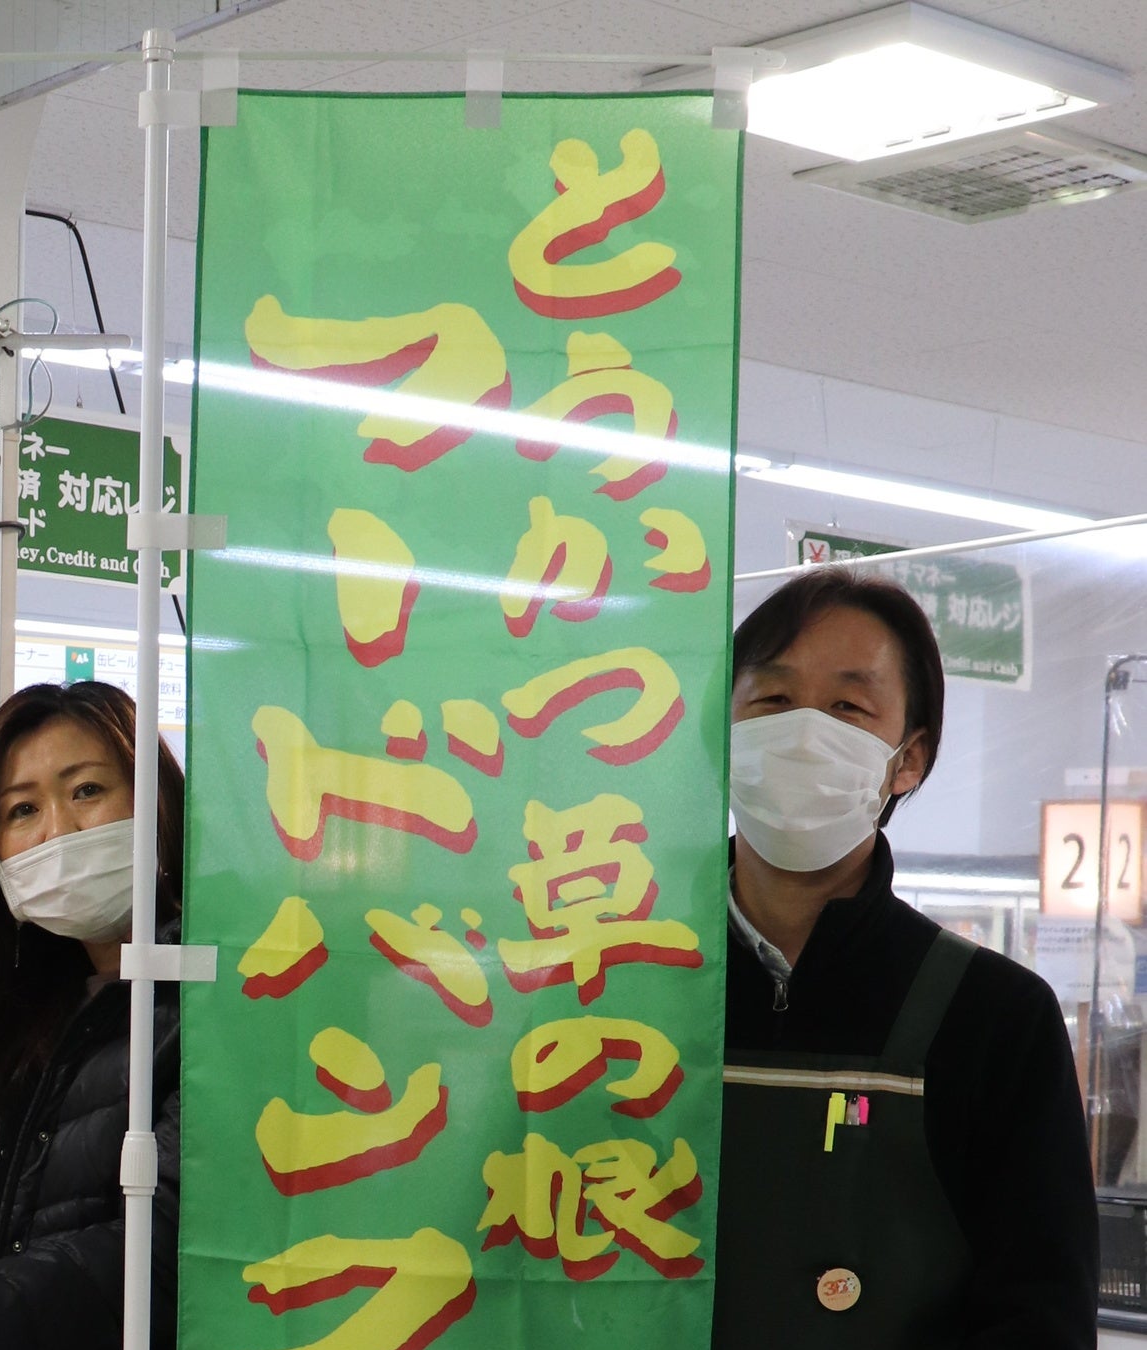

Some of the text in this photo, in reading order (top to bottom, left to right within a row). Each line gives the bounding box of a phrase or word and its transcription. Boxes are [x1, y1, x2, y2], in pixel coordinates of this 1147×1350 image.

[19, 432, 70, 461] ネー
[100, 556, 129, 573] and
[476, 128, 710, 1282] とうかつ草の根
[1061, 833, 1086, 890] 2
[1118, 833, 1133, 890] 2
